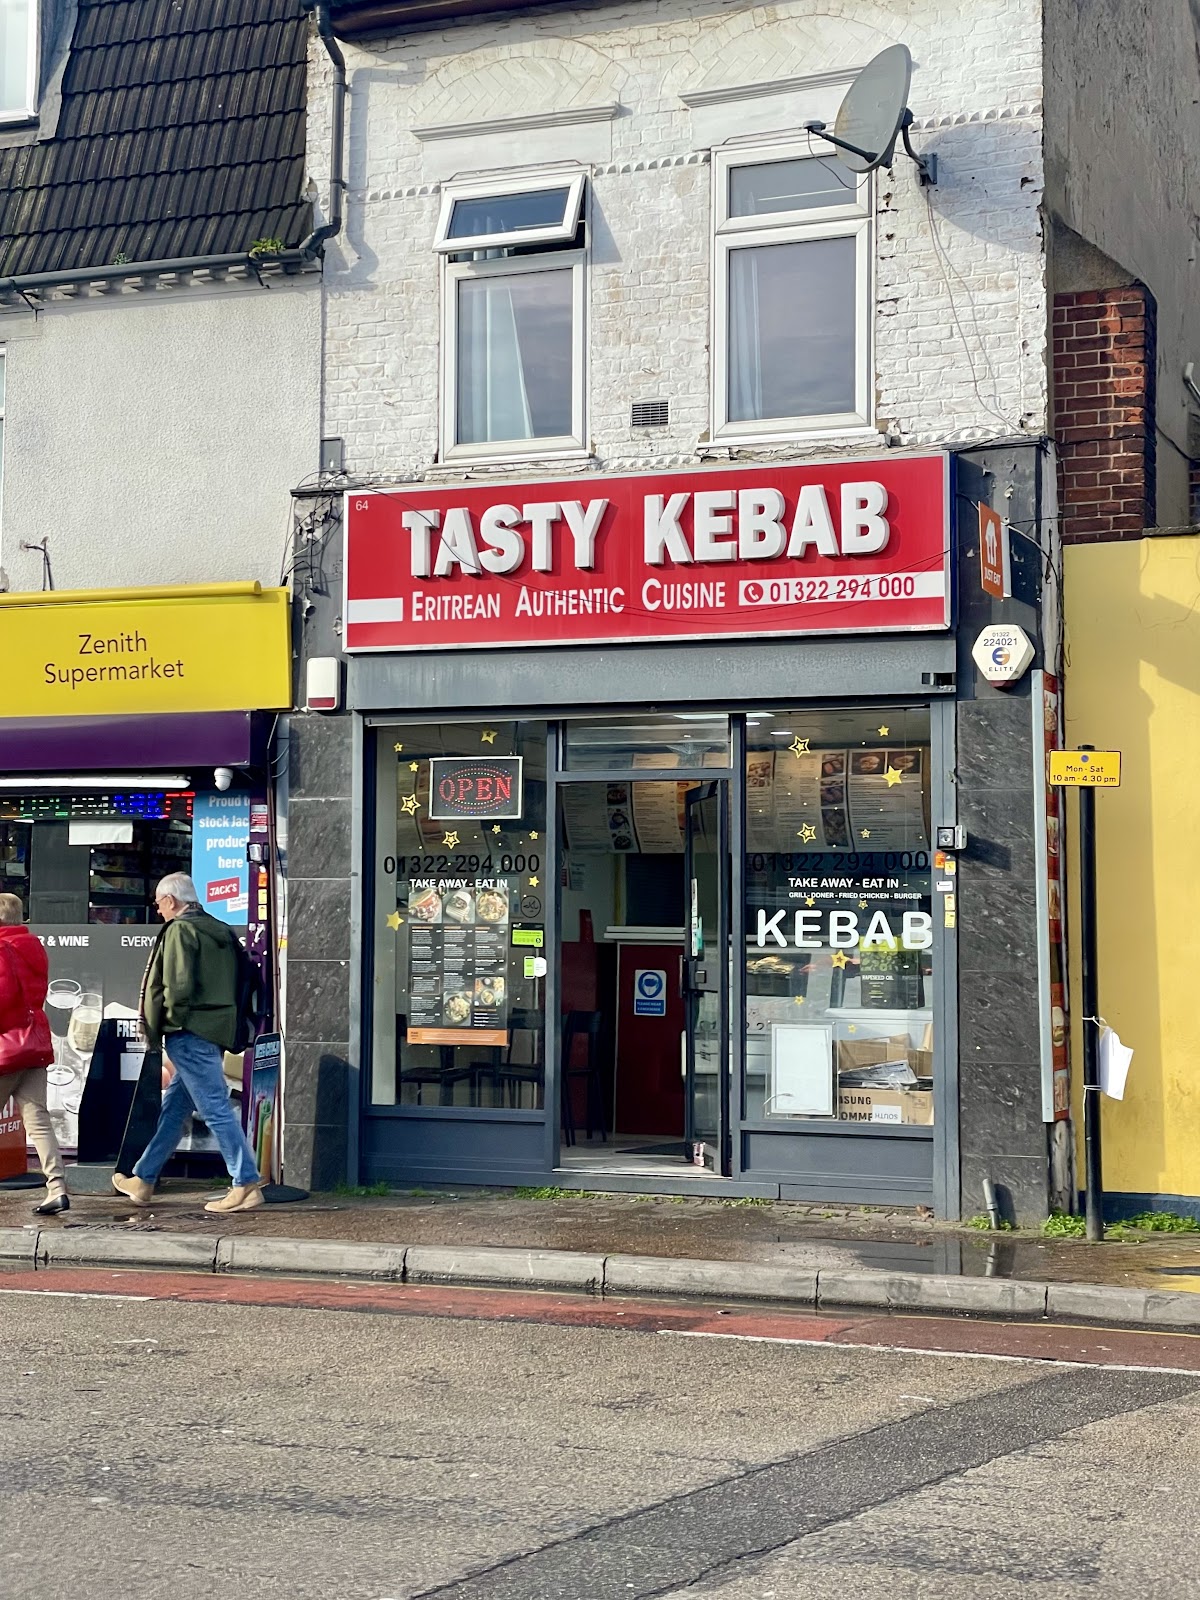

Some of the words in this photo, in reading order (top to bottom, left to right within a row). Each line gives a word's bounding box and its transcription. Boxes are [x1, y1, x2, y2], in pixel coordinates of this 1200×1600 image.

[354, 499, 369, 511] 64
[401, 498, 610, 578] TASTY
[643, 480, 889, 566] KEBAB
[984, 566, 994, 582] JUST
[993, 571, 1001, 586] EAT
[769, 579, 829, 602] 01322
[836, 578, 872, 600] 294
[878, 576, 915, 597] 000
[78, 630, 148, 655] Zenith
[983, 637, 1018, 647] 224021
[44, 657, 185, 690] Supermarket
[1090, 765, 1104, 773] Sat
[1053, 774, 1063, 782] 10
[438, 776, 513, 802] OPEN
[208, 795, 243, 808] Proud
[199, 815, 230, 829] stock
[230, 815, 250, 828] Jac
[206, 835, 250, 852] product
[217, 855, 244, 869] here
[383, 854, 448, 875] 01322
[455, 853, 494, 874] 294
[500, 853, 540, 873] 000
[832, 852, 875, 872] 294
[884, 850, 929, 871] 000
[209, 882, 239, 897] JACK'S
[409, 878, 437, 889] TAKE
[438, 878, 468, 888] AWAY
[475, 878, 495, 888] EAT
[496, 878, 508, 888] IN
[787, 877, 819, 888] TAKE
[820, 877, 854, 888] AWAY
[862, 878, 885, 888] EAT
[886, 878, 899, 889] IN
[859, 892, 890, 900] CHICKEN
[894, 892, 922, 900] BURGER
[757, 908, 932, 950] KEBAB
[46, 935, 56, 947] &
[58, 935, 90, 947] WINE
[121, 935, 157, 947] EVERY
[116, 1019, 138, 1038] FRE
[840, 1095, 872, 1105] SUNG
[8, 1120, 21, 1133] EAT
